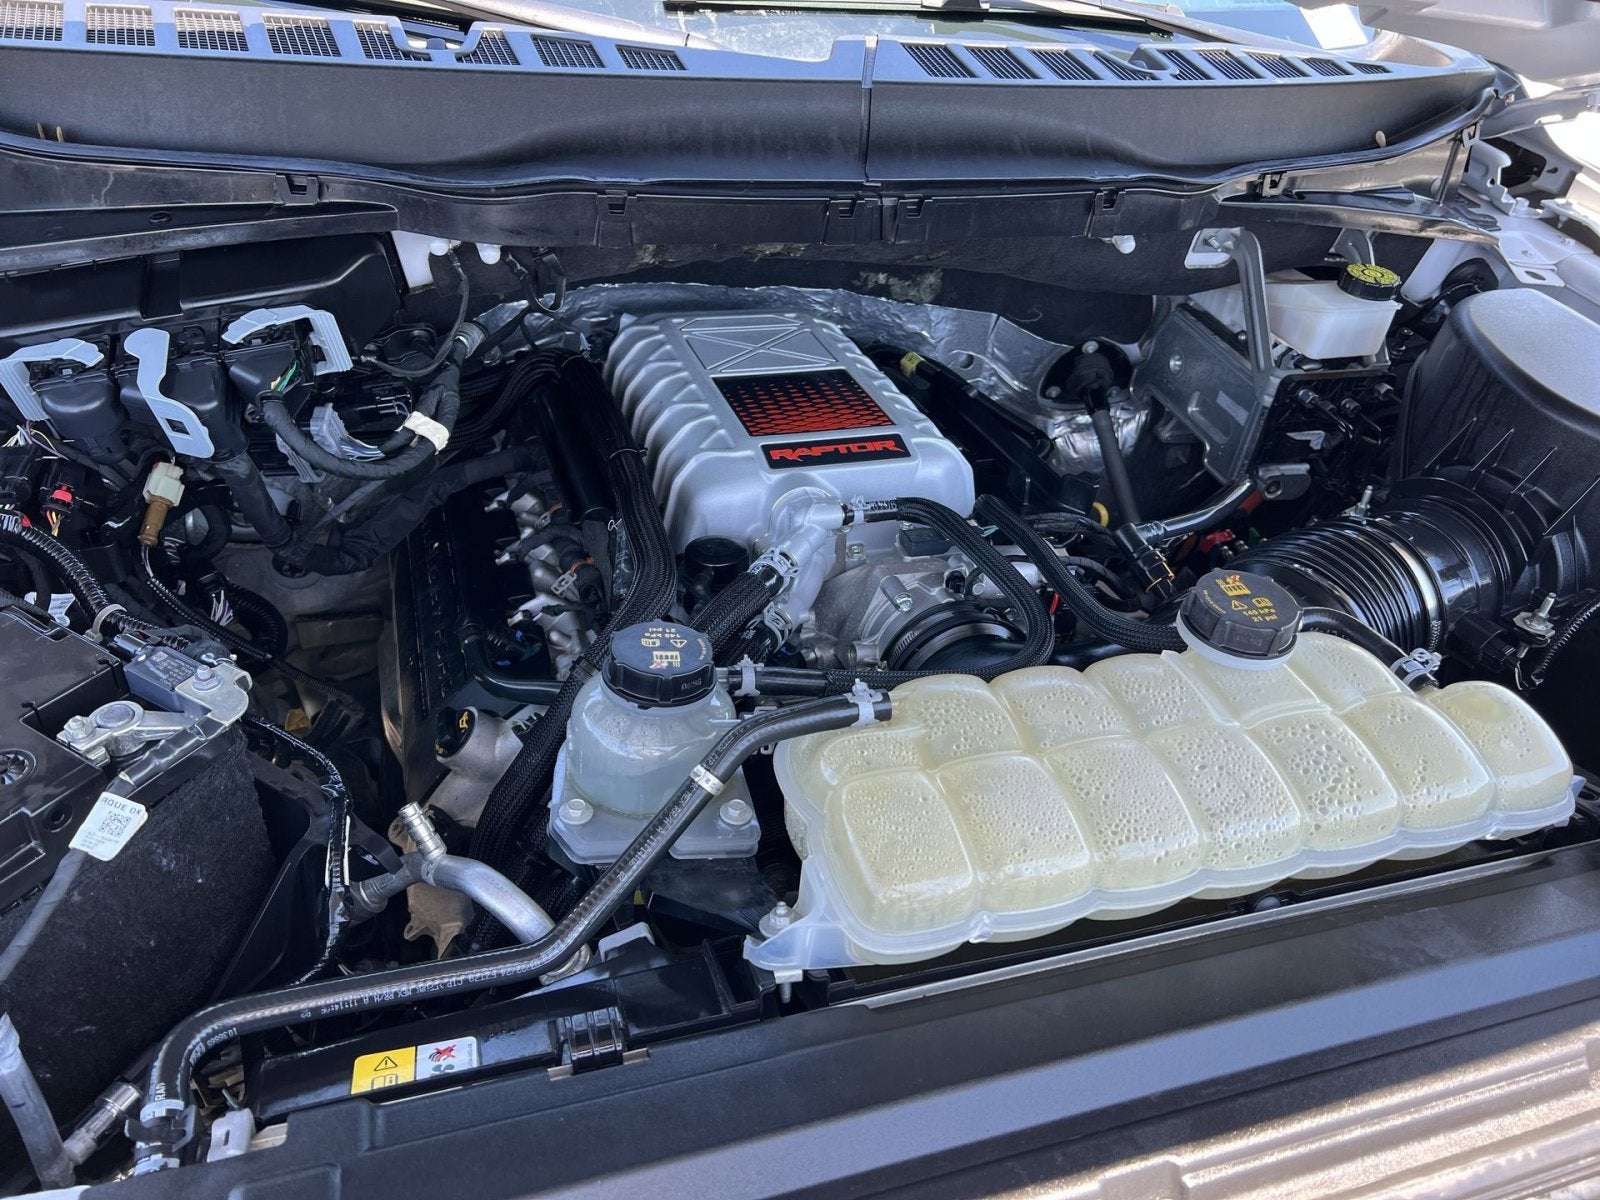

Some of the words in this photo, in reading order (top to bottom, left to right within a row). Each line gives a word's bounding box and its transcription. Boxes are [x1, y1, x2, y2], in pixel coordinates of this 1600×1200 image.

[769, 440, 904, 462] RAPTOR
[1264, 614, 1278, 622] psi
[446, 978, 463, 988] CIP
